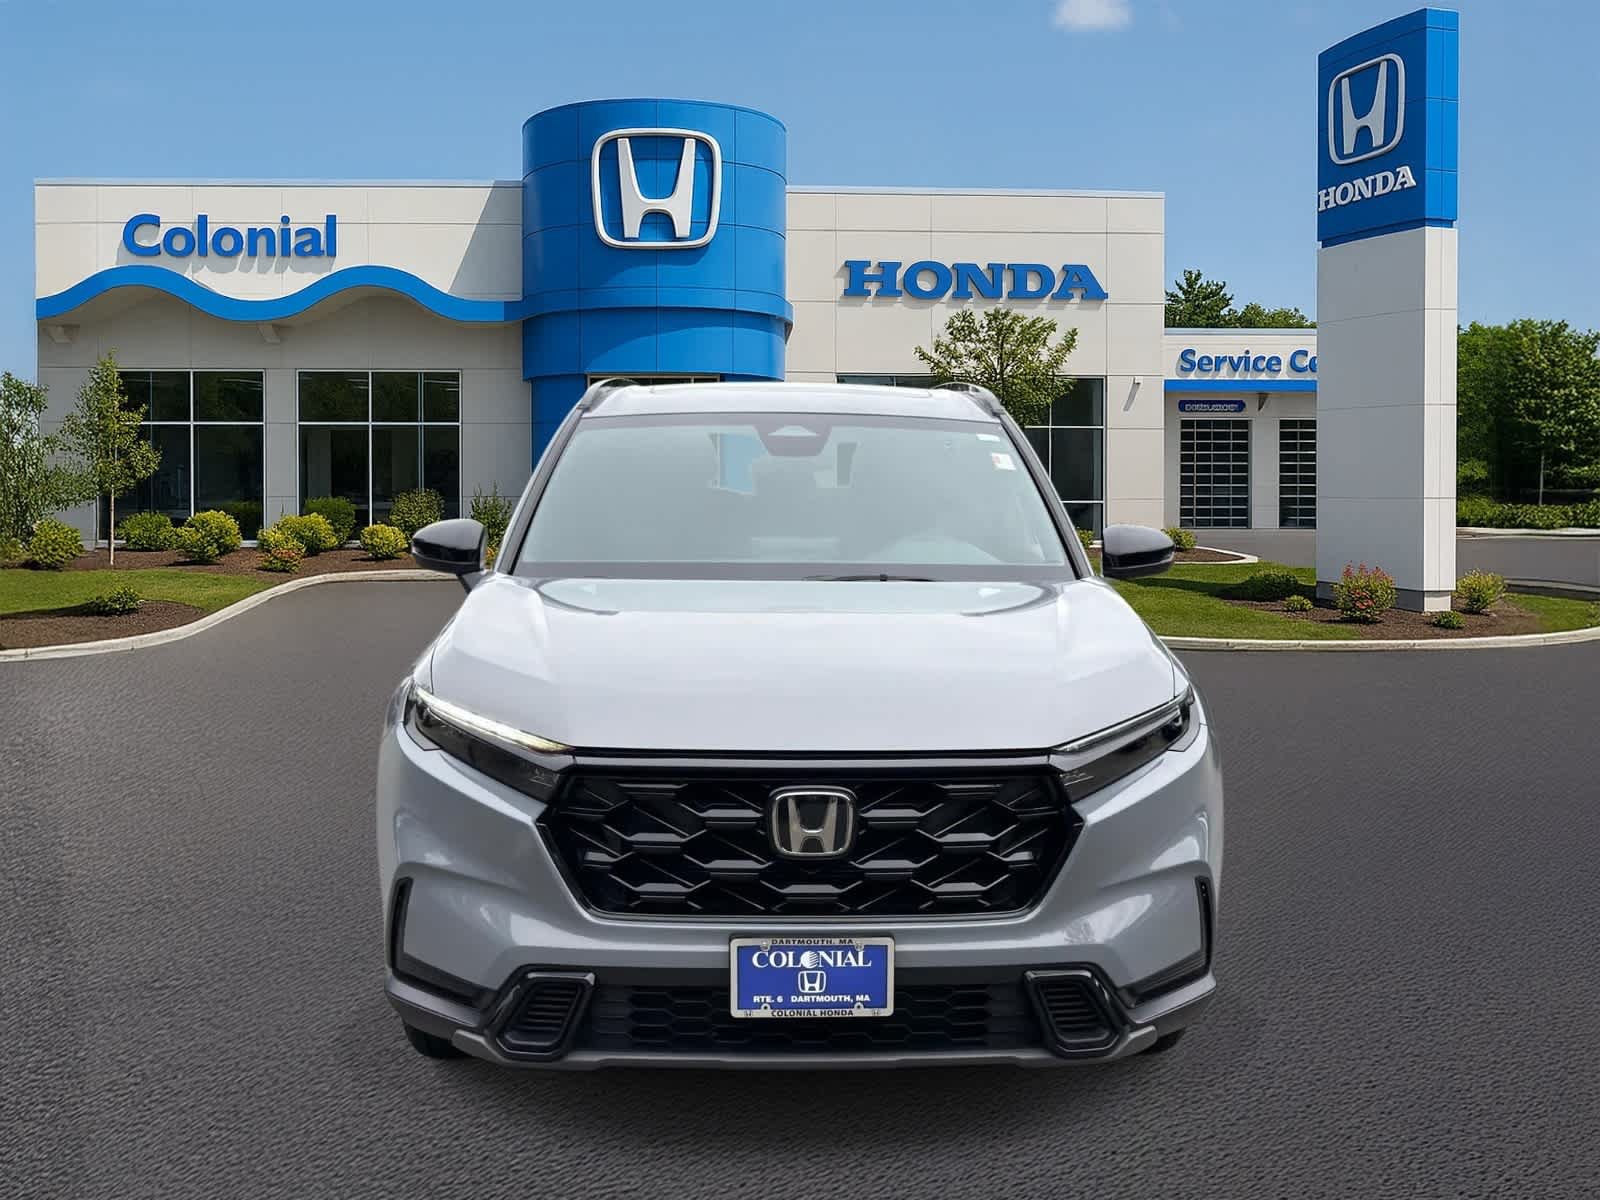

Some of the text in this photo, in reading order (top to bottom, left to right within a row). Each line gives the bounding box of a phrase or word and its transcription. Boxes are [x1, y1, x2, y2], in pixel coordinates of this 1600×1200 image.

[1317, 164, 1417, 212] HONDA
[122, 213, 338, 257] Colonial
[843, 260, 1109, 300] HONDA
[1180, 348, 1282, 373] Service
[752, 950, 872, 969] COLONIAL
[753, 994, 871, 1004] RTE. 6 DARTMOUTH, MA
[820, 1009, 854, 1017] HONDA
